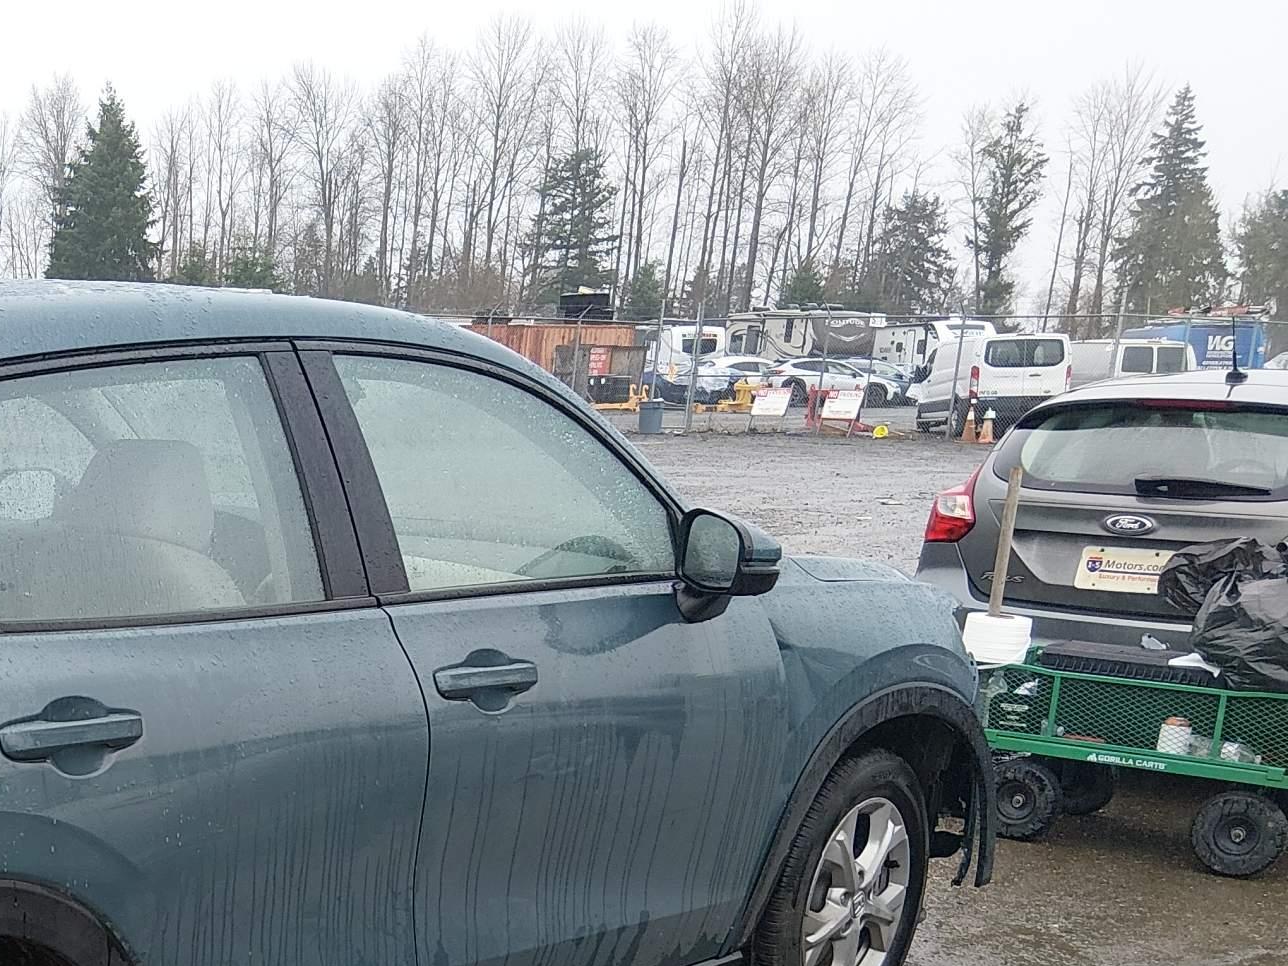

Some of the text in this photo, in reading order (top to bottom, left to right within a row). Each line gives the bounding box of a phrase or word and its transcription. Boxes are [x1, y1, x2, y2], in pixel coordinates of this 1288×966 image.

[1115, 518, 1142, 530] Ford
[1098, 754, 1165, 770] GORILLA CARTS
